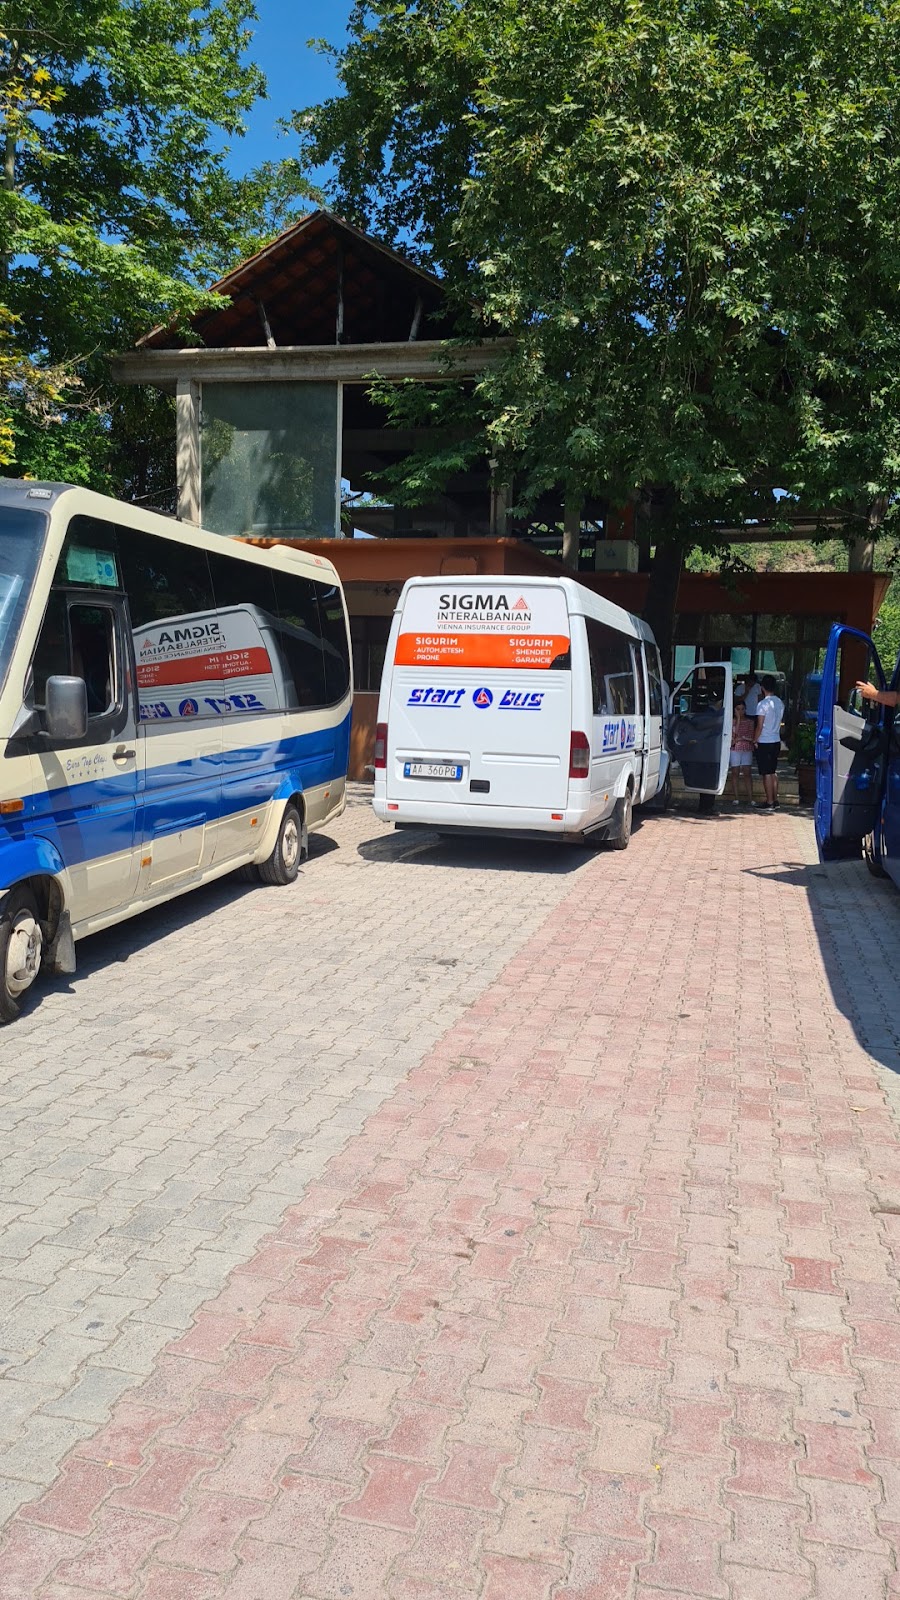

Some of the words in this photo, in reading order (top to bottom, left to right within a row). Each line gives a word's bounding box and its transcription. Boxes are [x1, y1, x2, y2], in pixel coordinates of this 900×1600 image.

[439, 594, 509, 610] SIGMA
[437, 612, 532, 621] INTERALBANIAN
[416, 637, 458, 645] SIGURIM
[509, 638, 553, 647] SIGURIM
[407, 687, 467, 704] start
[499, 690, 545, 706] bus
